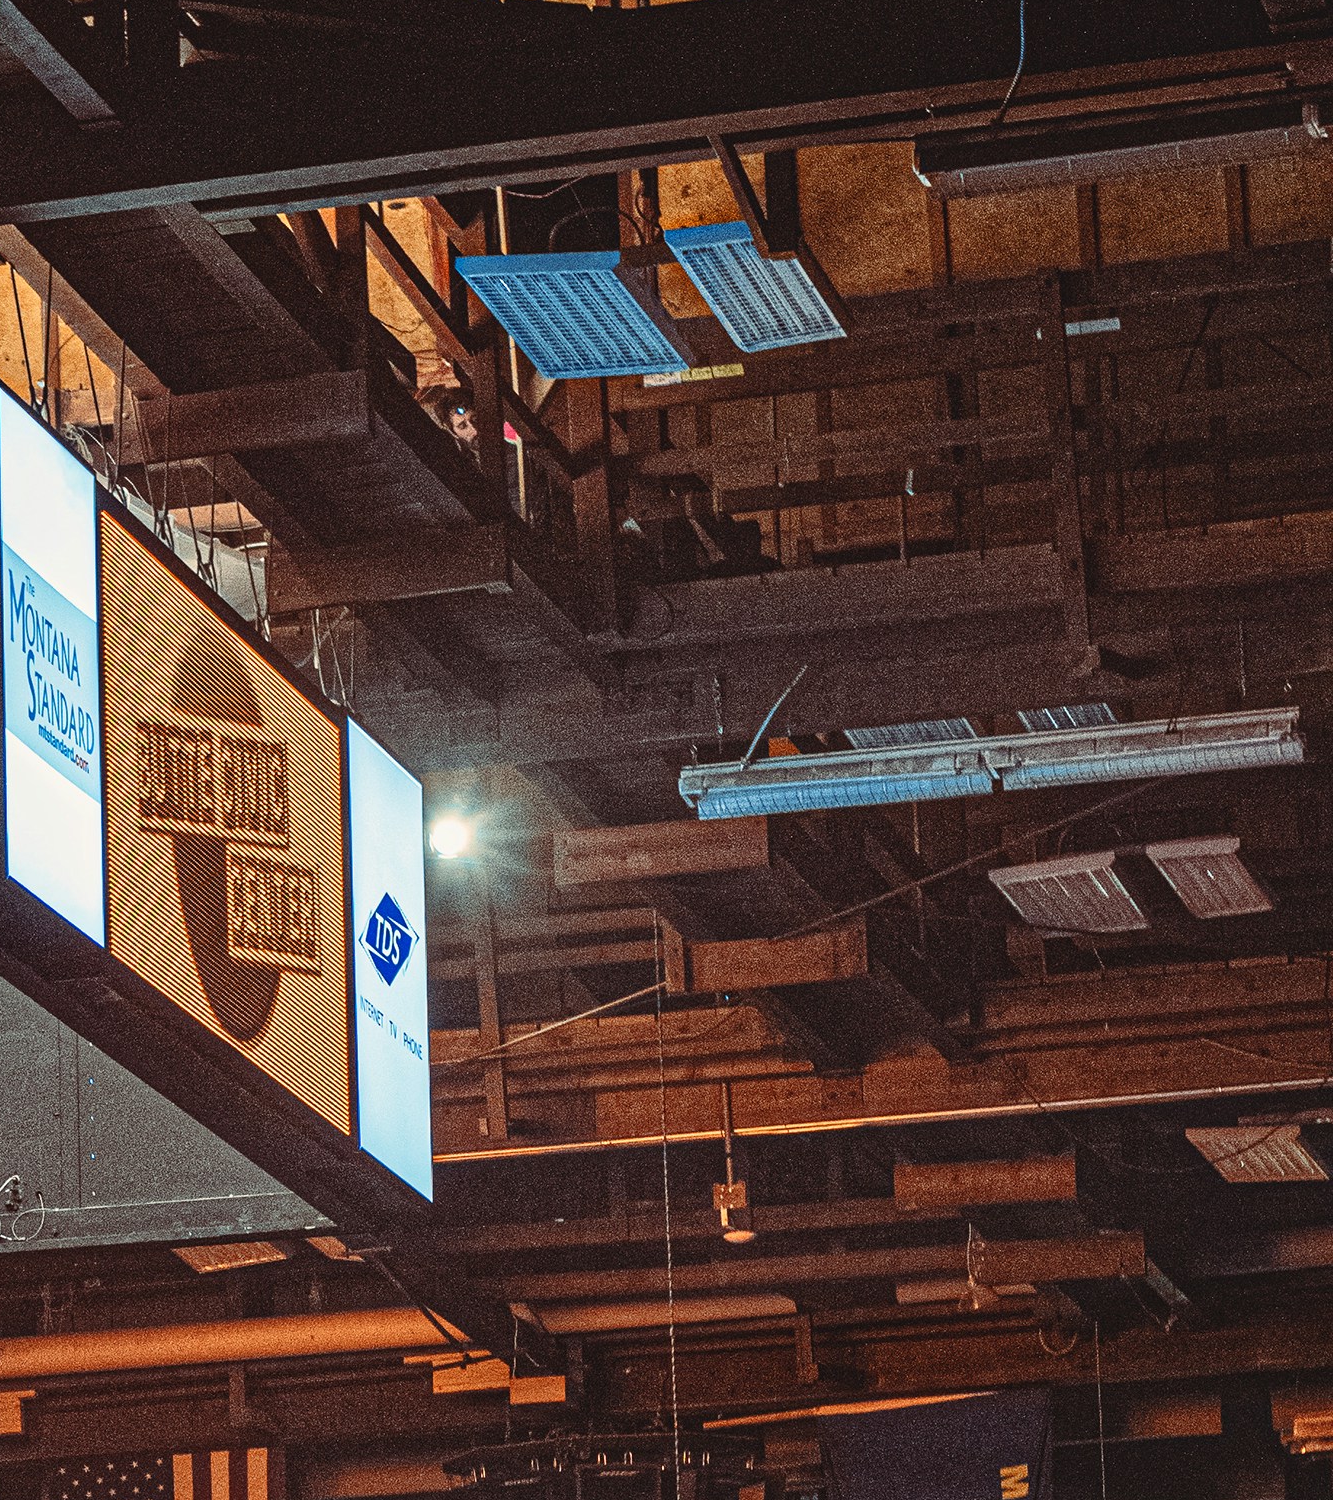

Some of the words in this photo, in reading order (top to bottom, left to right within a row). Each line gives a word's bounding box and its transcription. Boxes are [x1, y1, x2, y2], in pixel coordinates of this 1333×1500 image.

[25, 575, 35, 597] The
[38, 723, 90, 774] mtstandard.com
[375, 912, 401, 965] TDS
[360, 995, 384, 1028] INTERNET
[389, 1020, 397, 1039] TV
[403, 1031, 423, 1060] PHONE
